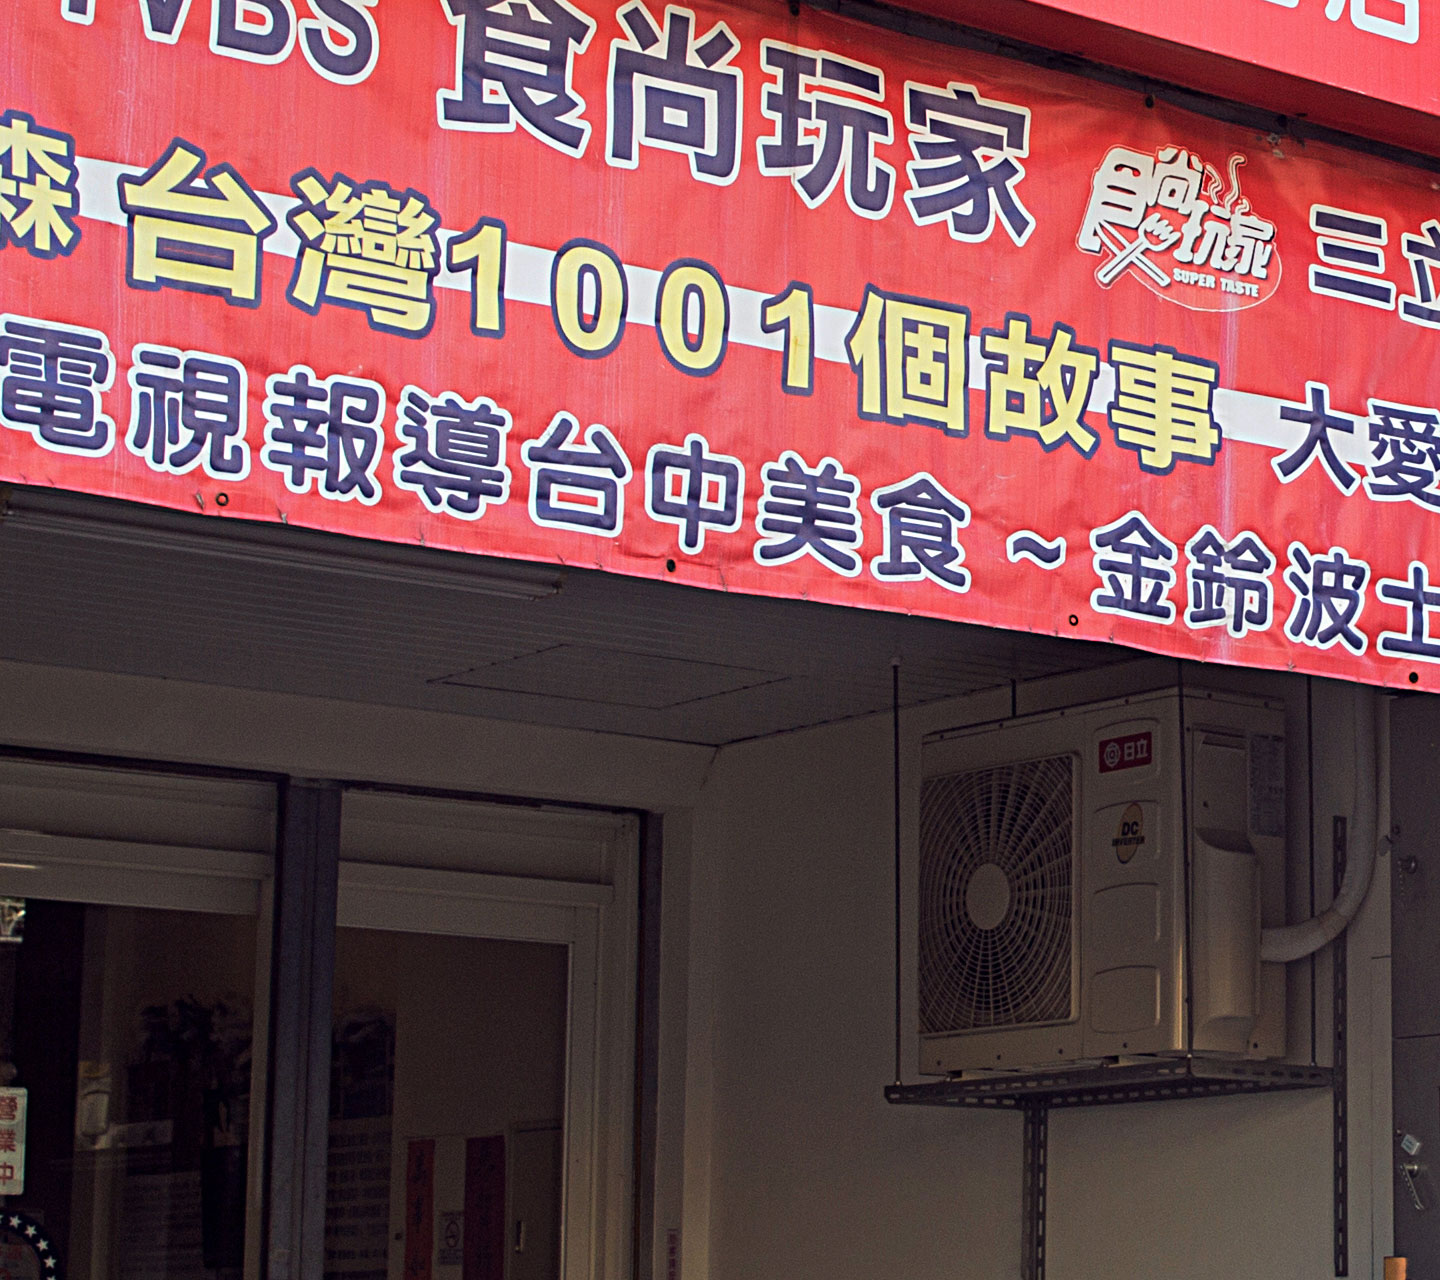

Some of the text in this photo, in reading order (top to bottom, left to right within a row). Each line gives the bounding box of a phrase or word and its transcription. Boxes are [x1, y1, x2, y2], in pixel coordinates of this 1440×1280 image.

[1173, 268, 1259, 298] SUPER TASTE
[118, 136, 1222, 476] 台灣1001個故事
[1123, 738, 1149, 761] 日立
[1122, 820, 1139, 836] DC
[1112, 835, 1145, 847] INVERTER
